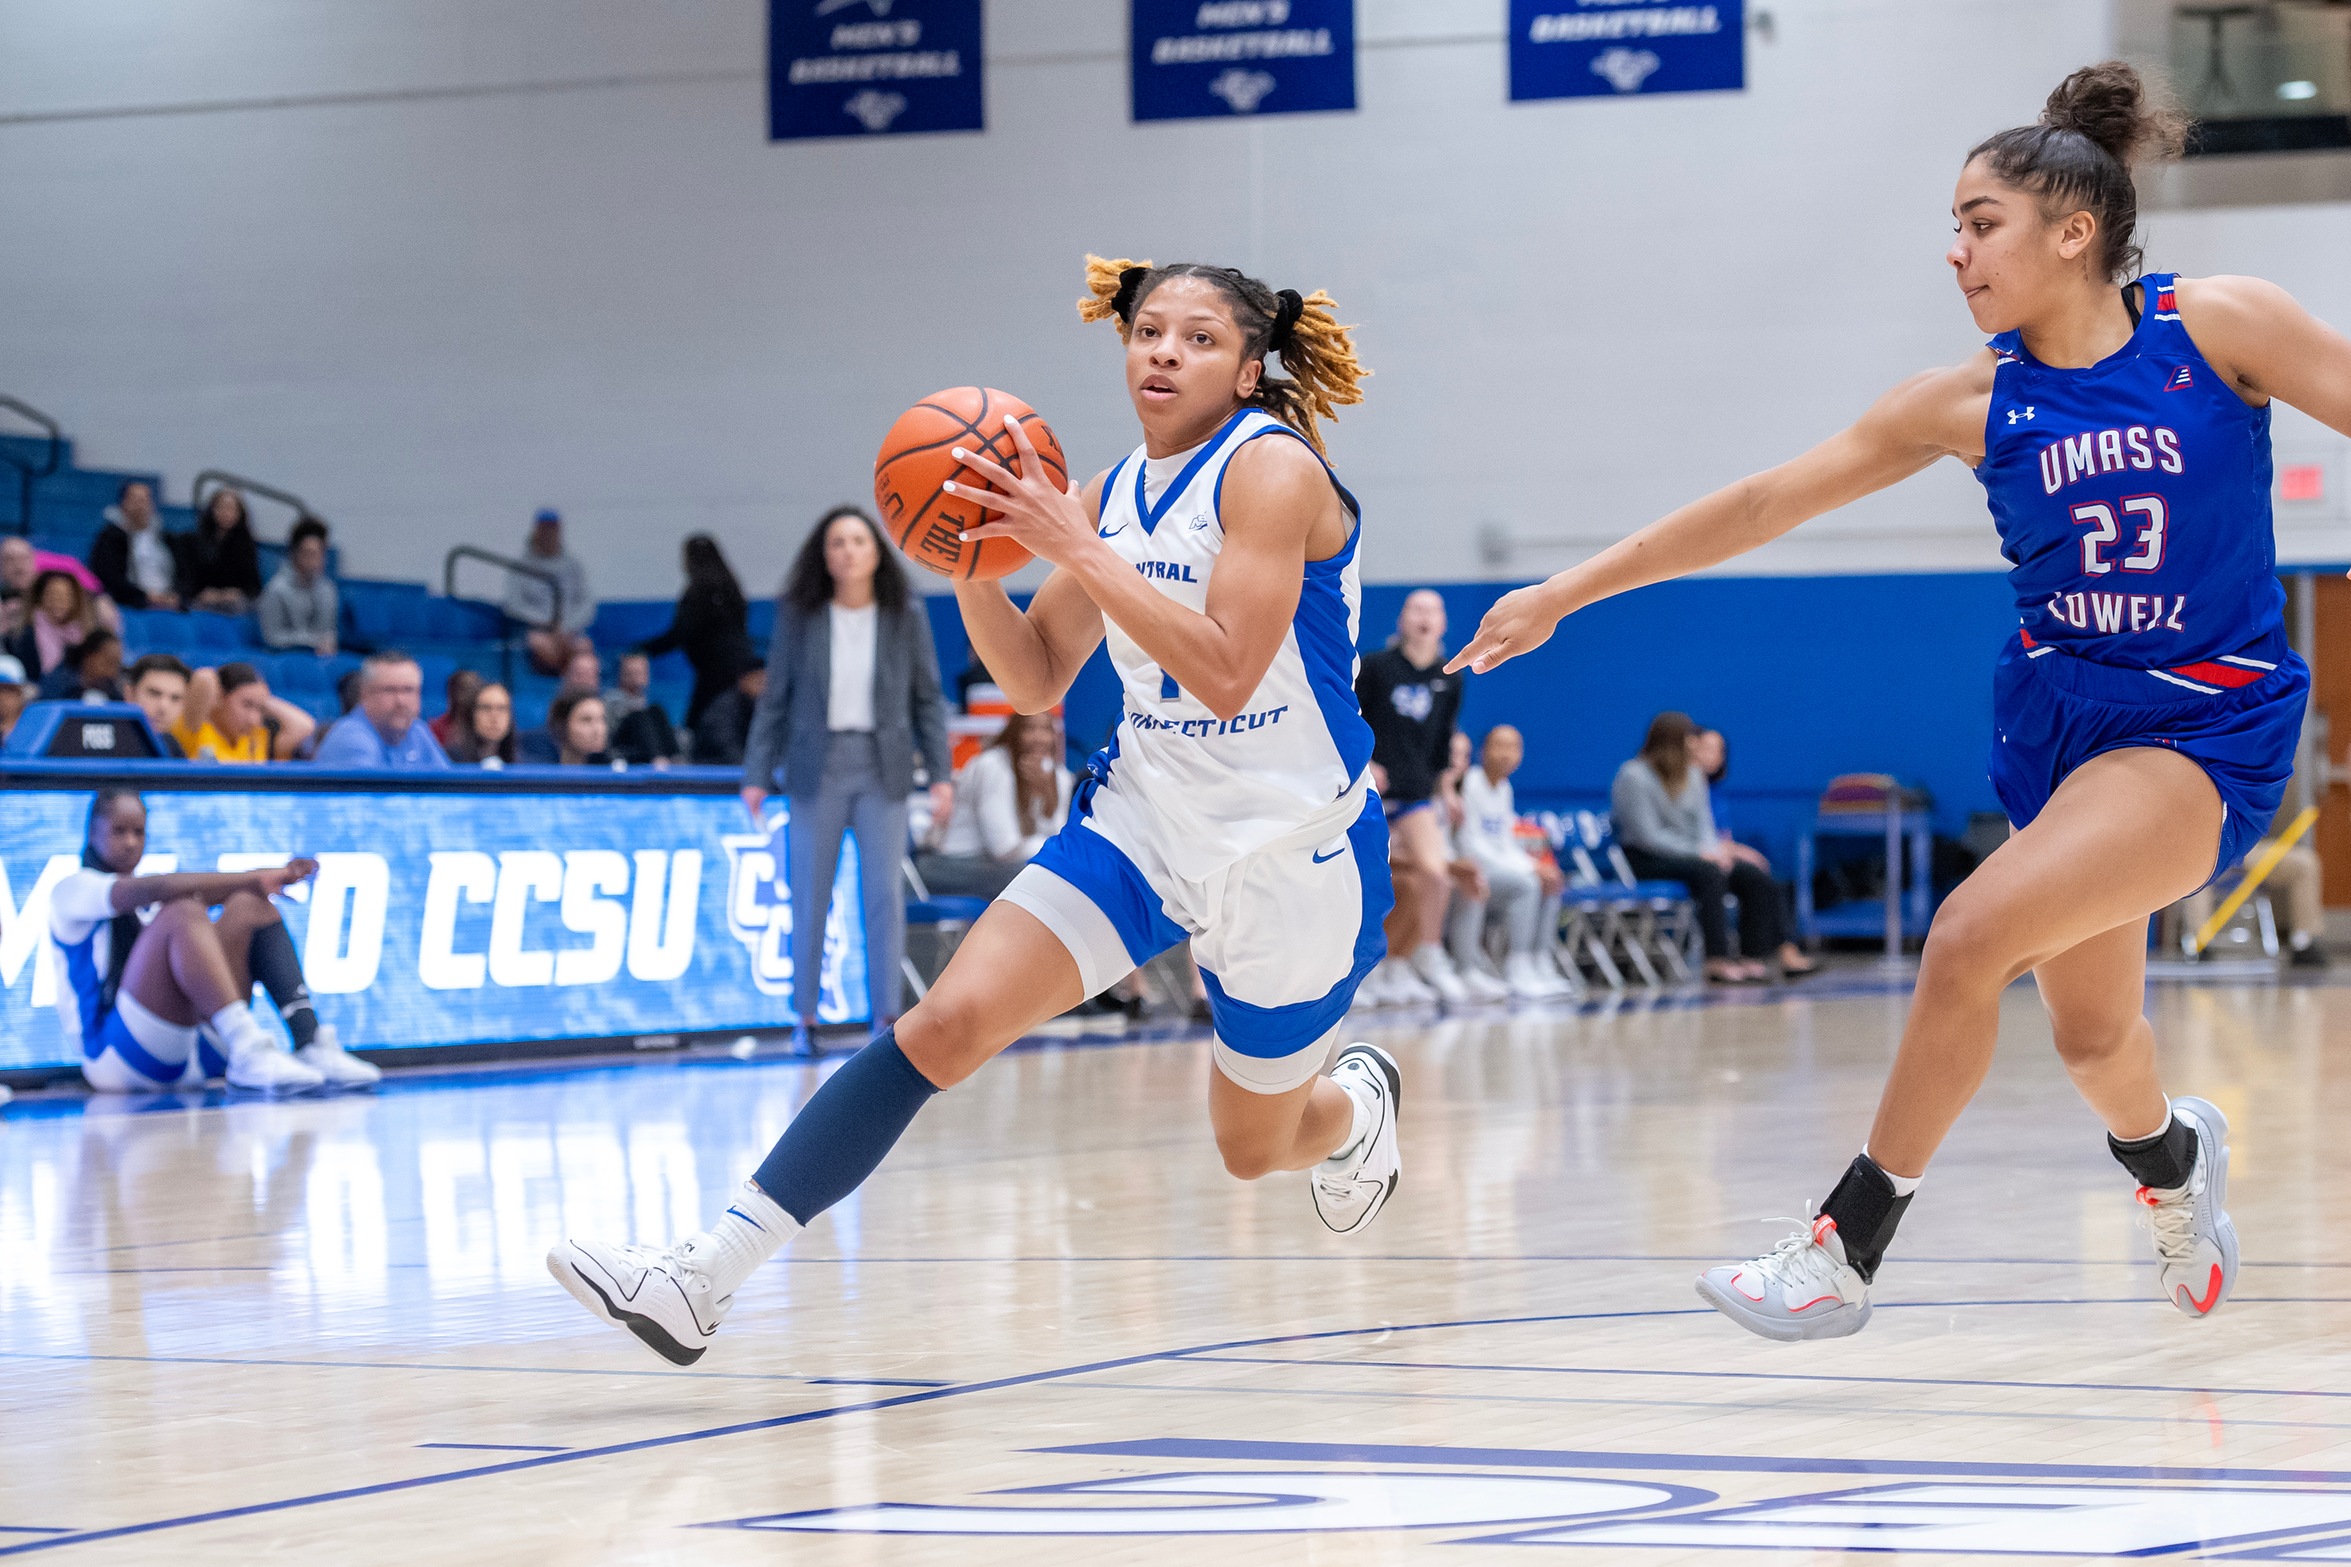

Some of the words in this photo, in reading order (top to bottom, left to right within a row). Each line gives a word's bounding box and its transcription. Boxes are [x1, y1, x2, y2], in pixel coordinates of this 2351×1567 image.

[2039, 426, 2184, 496] UMASS
[919, 511, 965, 563] THE
[2069, 493, 2169, 577] 23
[1133, 561, 1198, 584] NTRAL
[2047, 590, 2188, 635] LOWELL
[418, 849, 703, 990] CCSU
